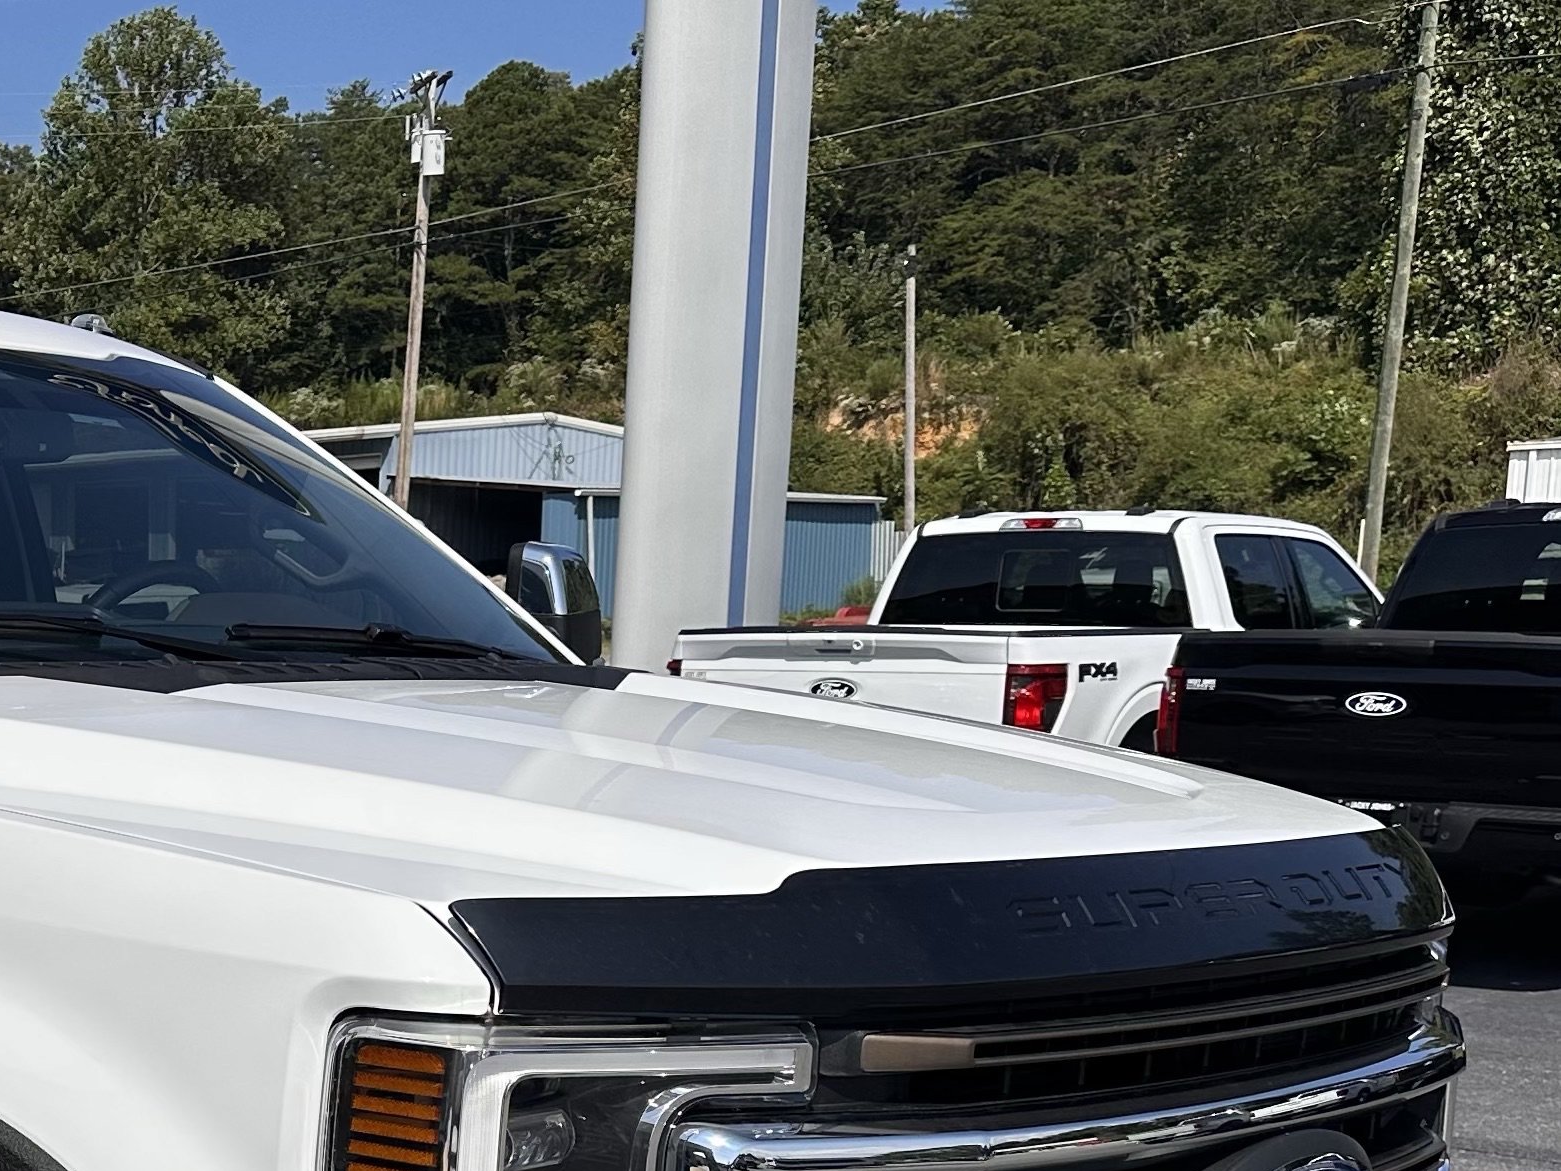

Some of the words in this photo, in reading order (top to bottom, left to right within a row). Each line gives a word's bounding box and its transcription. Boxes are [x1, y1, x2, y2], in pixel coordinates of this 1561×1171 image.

[1078, 662, 1118, 682] FX4
[816, 682, 849, 698] Ford
[1354, 695, 1396, 712] Ford
[1006, 878, 1286, 936] SUPER
